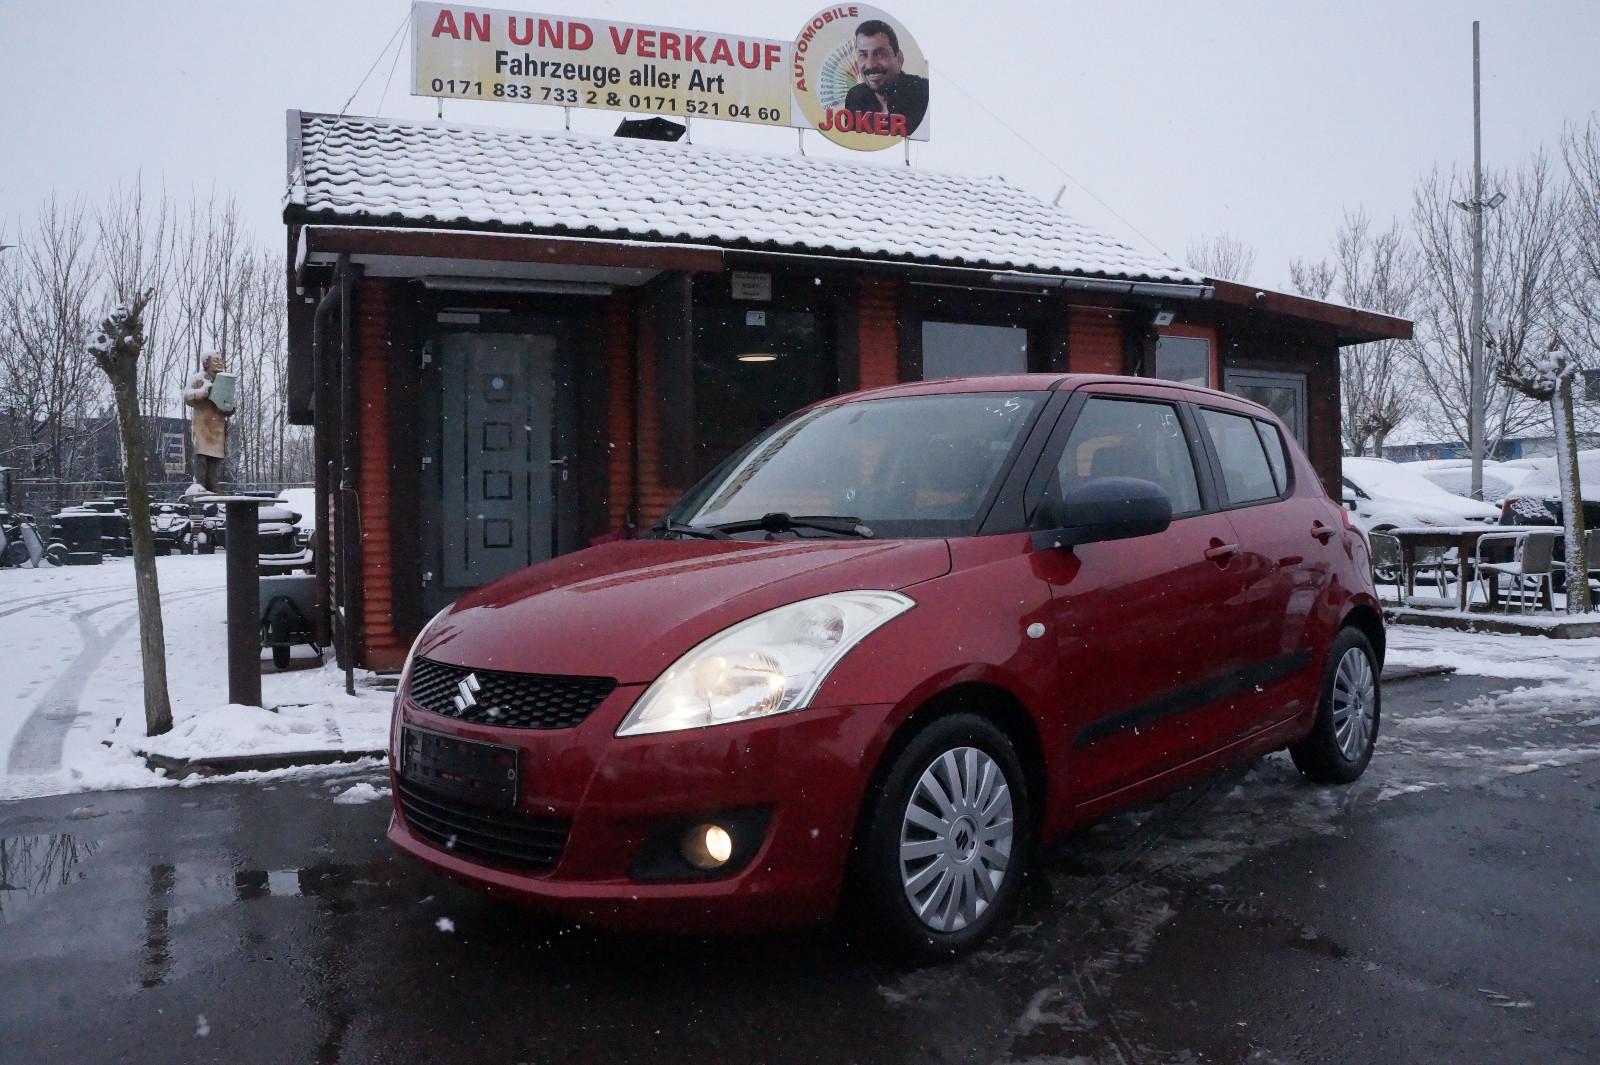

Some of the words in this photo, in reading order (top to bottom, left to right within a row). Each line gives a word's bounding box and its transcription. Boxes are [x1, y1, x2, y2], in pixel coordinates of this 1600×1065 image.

[431, 9, 491, 42] AN
[508, 16, 594, 51] UND
[608, 26, 781, 71] VERKAUF
[794, 6, 858, 92] AUTOMOBILE
[495, 50, 621, 88] Fahrzeuge
[629, 64, 681, 89] aller
[688, 69, 725, 94] Art
[431, 78, 482, 96] 0171
[493, 83, 532, 99] 833
[541, 87, 578, 103] 733
[586, 90, 598, 105] 2
[606, 92, 621, 107] &
[629, 94, 676, 111] 0171
[686, 99, 719, 115] 521
[728, 104, 751, 118] 04
[758, 107, 781, 121] 60
[818, 108, 907, 137] JOKER
